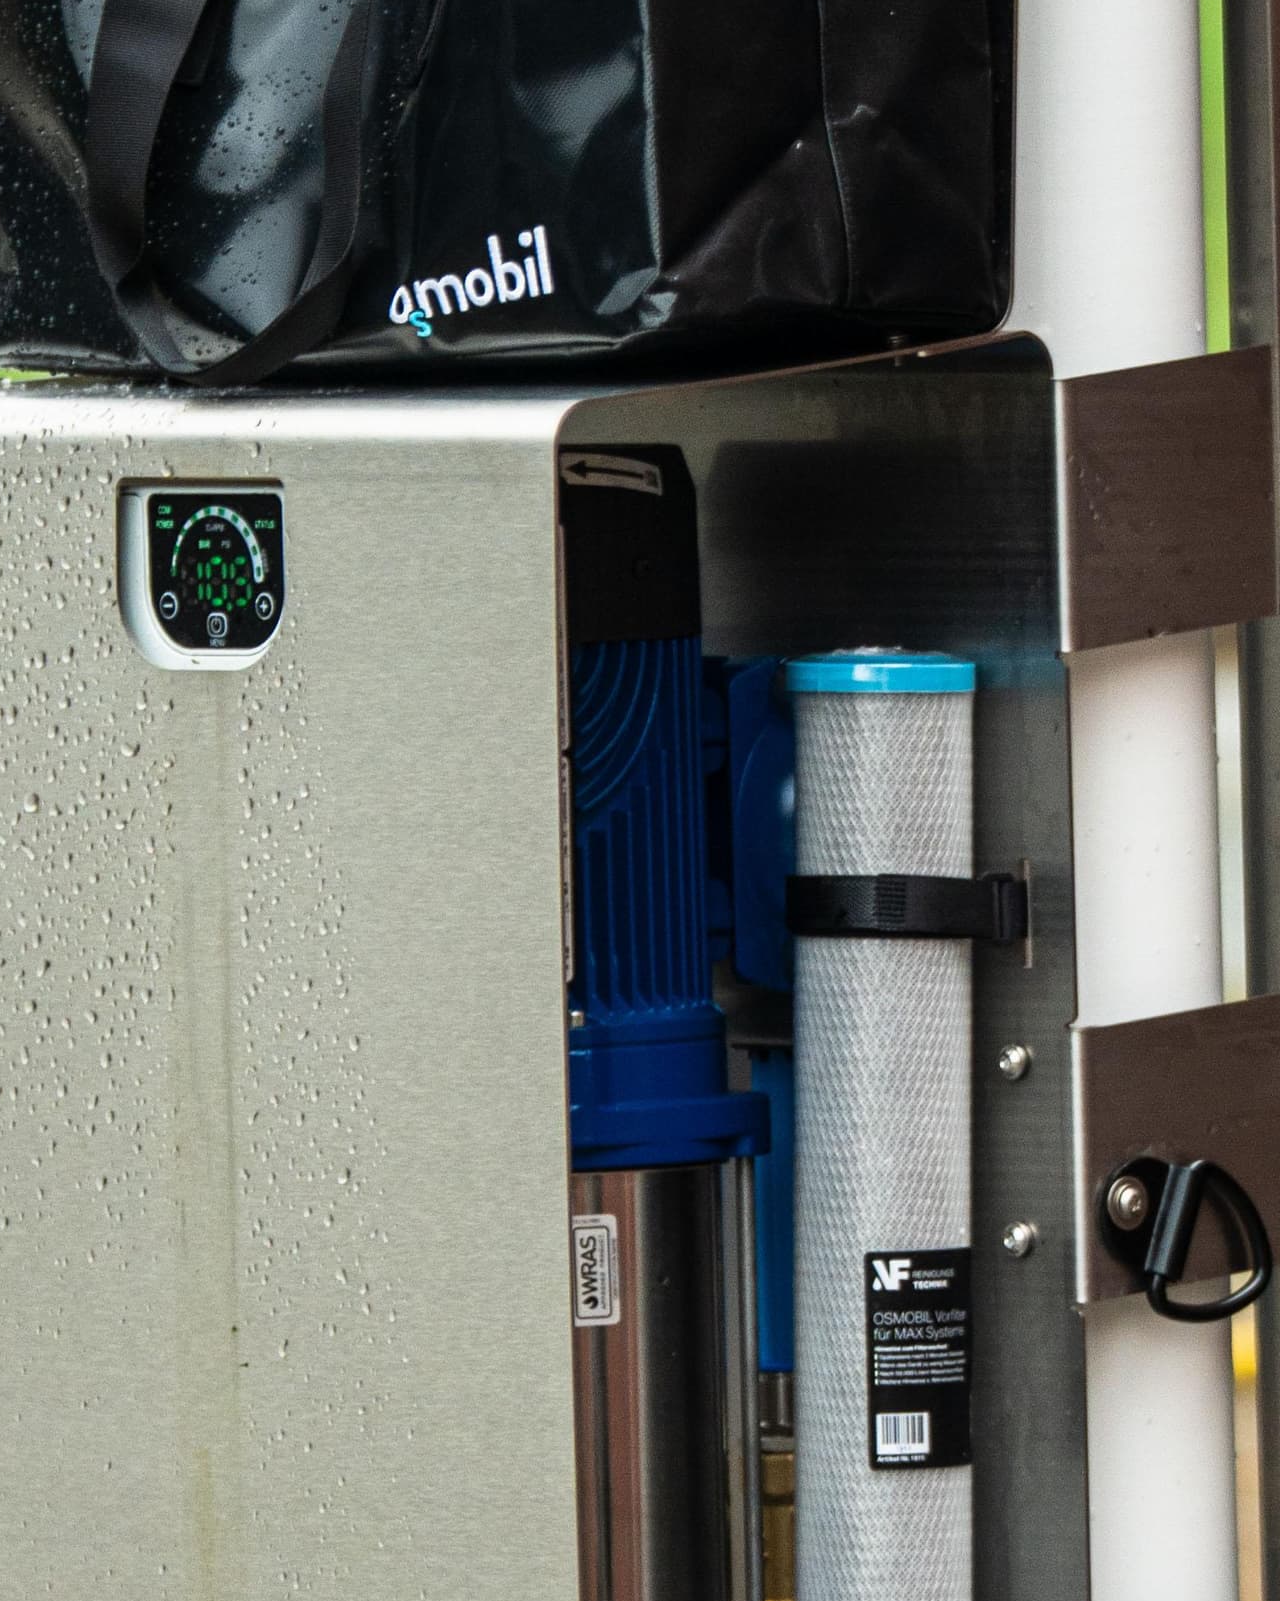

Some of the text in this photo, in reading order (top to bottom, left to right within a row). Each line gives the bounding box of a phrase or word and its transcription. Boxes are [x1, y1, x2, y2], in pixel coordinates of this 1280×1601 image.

[389, 225, 554, 337] osmobil
[580, 1236, 597, 1295] WRAS
[873, 1310, 933, 1326] OSMOBIL
[874, 1327, 890, 1341] für
[895, 1327, 924, 1340] MAX
